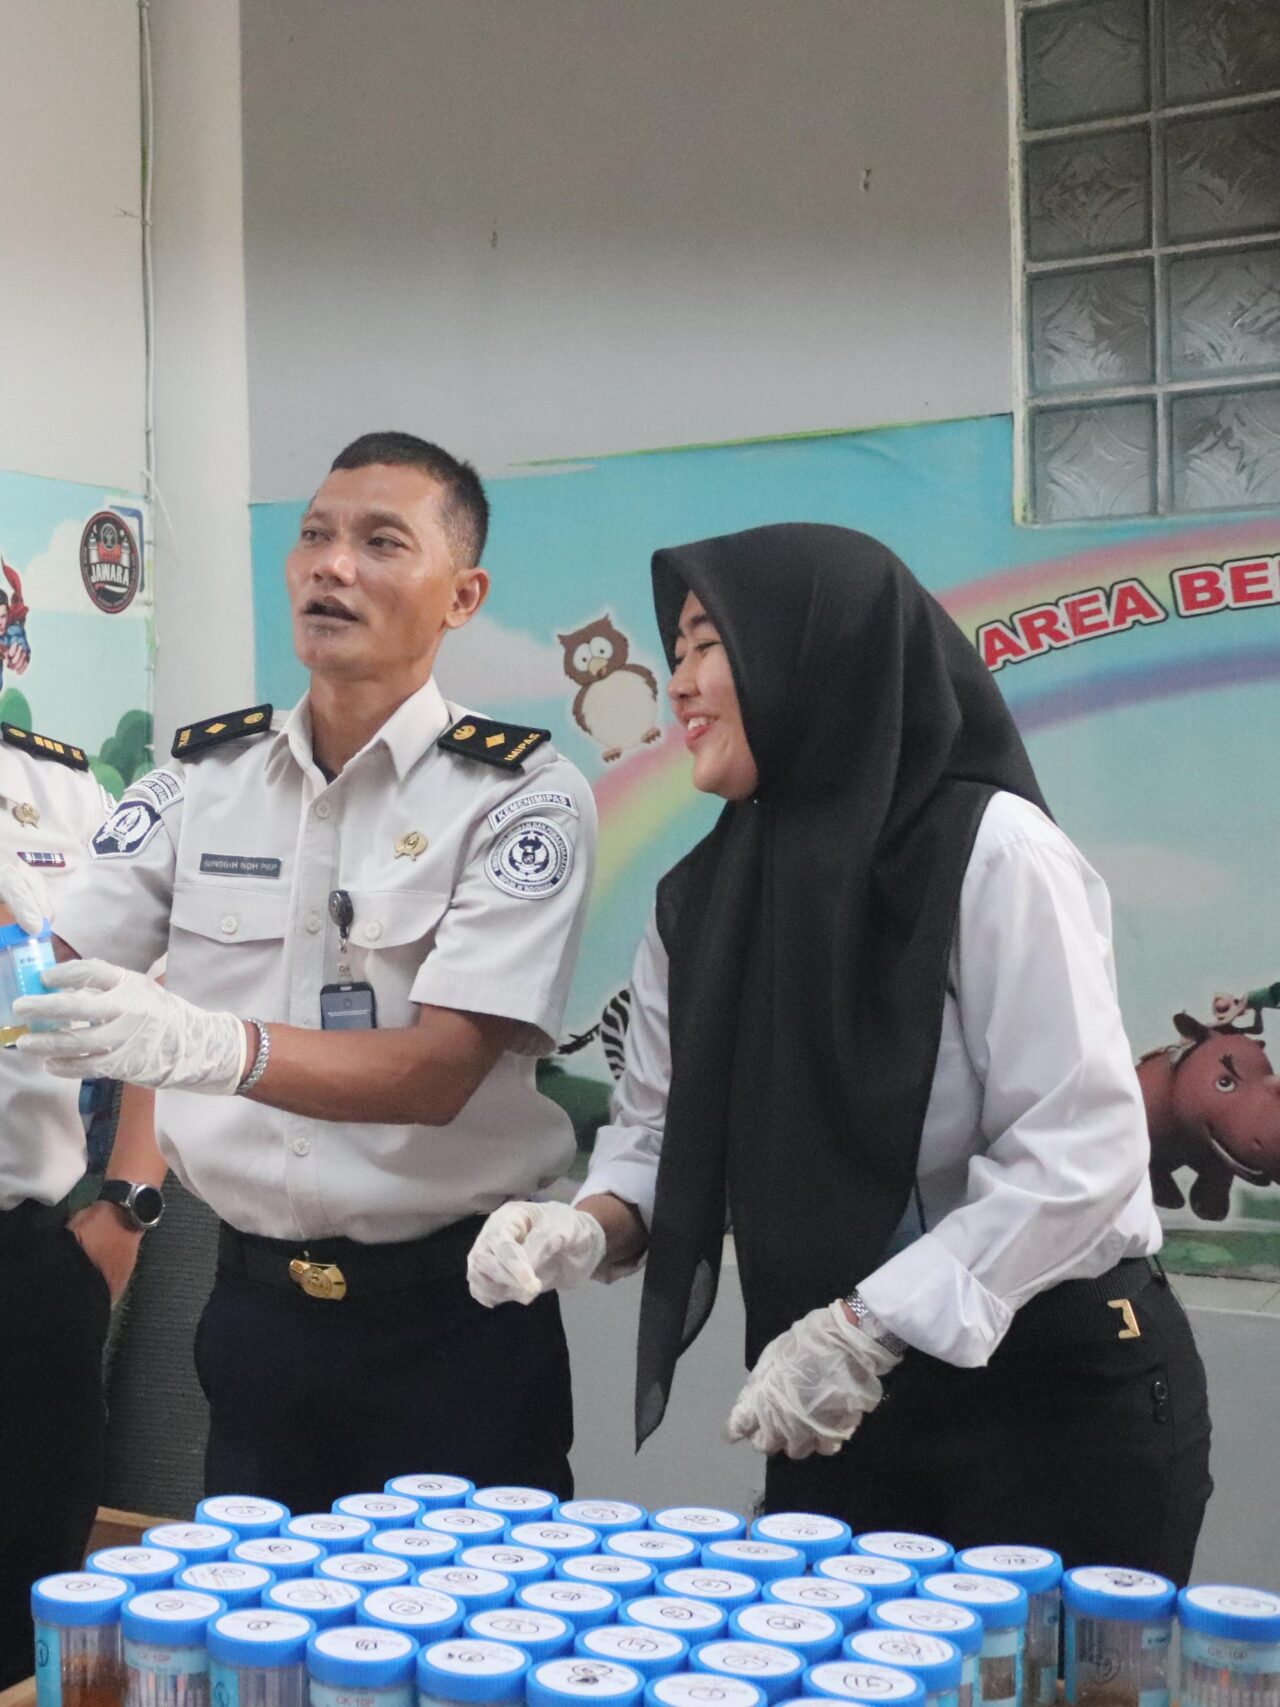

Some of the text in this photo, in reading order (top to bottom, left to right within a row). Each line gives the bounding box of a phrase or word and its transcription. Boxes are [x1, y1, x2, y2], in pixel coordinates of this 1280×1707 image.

[91, 564, 130, 586] JAWARA
[979, 556, 1280, 672] AREA BE
[504, 732, 541, 762] IMIPAS
[497, 793, 568, 821] KEMENIMIPAS
